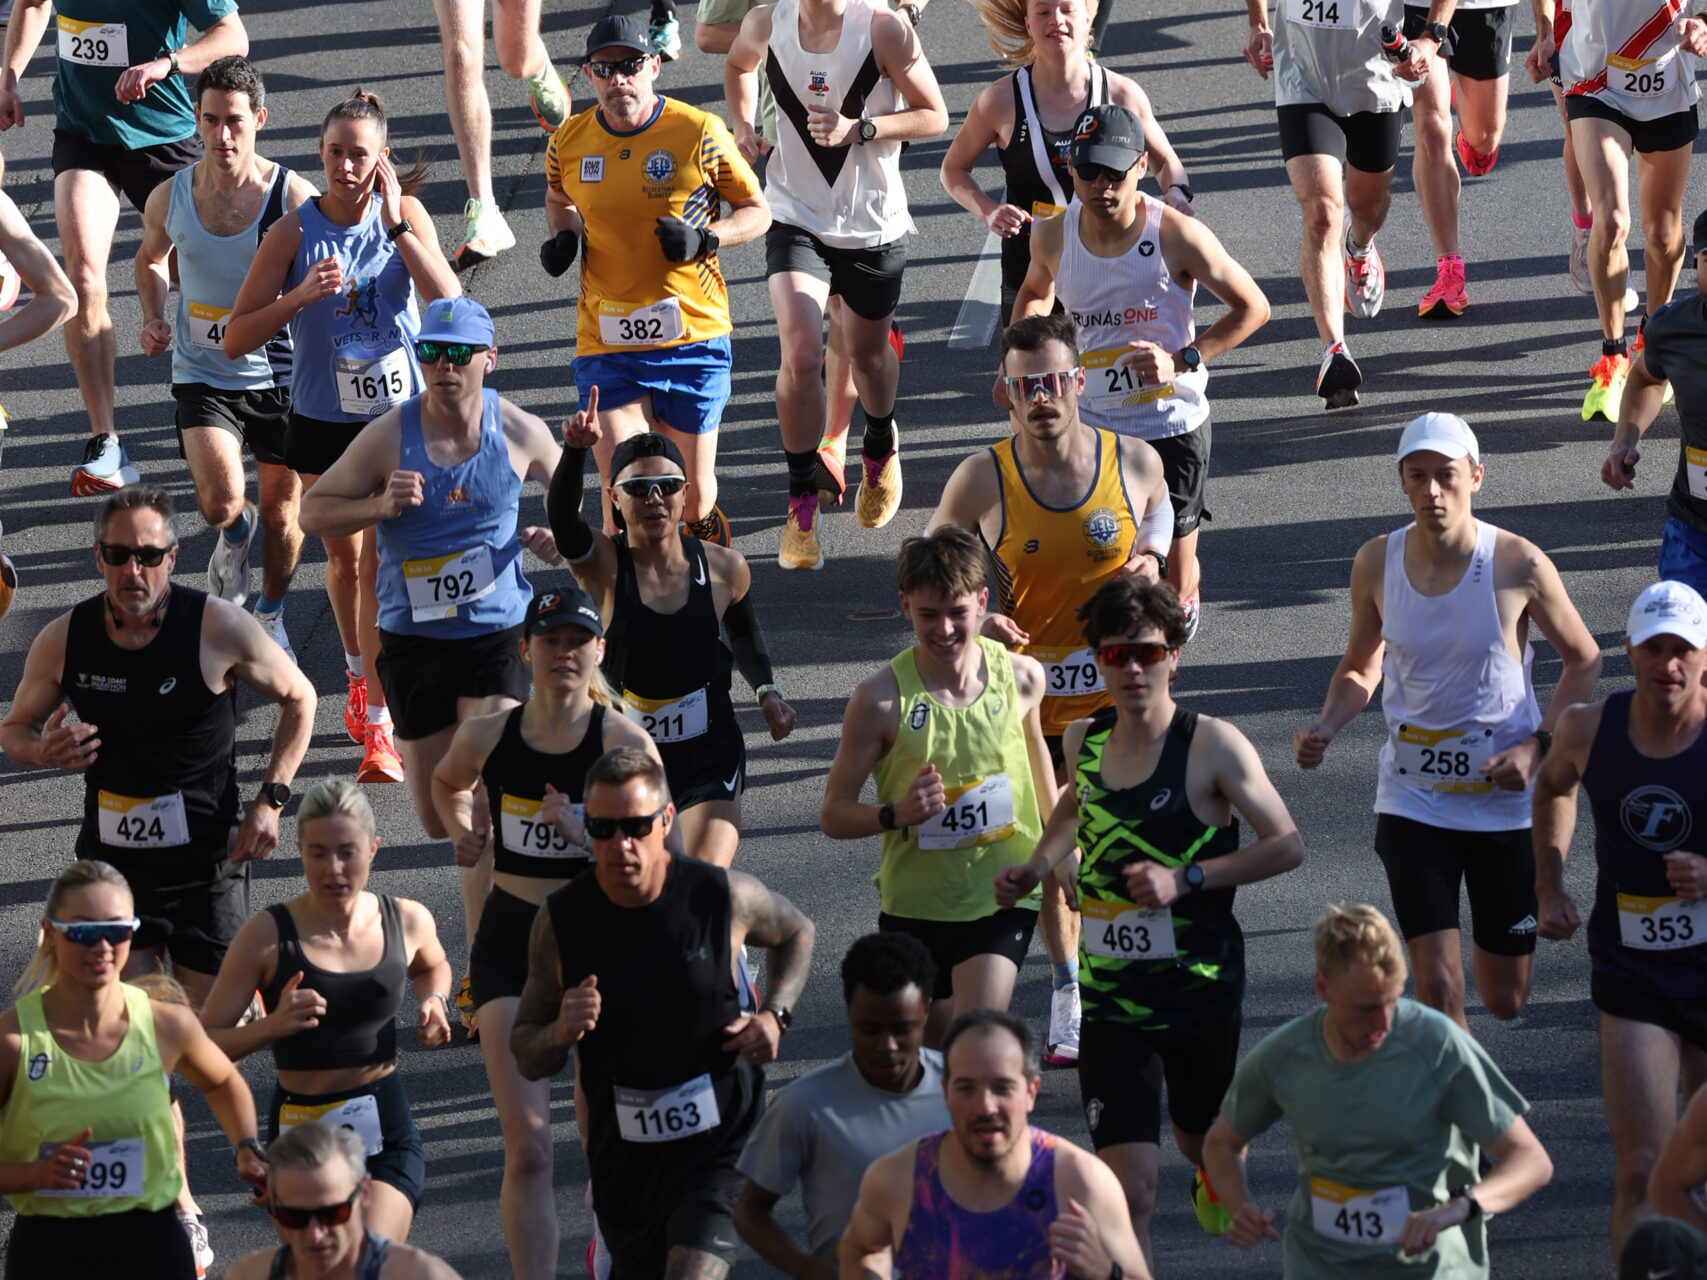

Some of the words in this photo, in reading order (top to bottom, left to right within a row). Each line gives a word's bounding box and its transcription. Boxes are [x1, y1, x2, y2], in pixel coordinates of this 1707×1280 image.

[71, 36, 110, 61] 239
[1623, 70, 1665, 93] 205
[647, 158, 671, 171] JETS
[333, 331, 362, 348] VETS
[619, 318, 664, 341] 382
[350, 371, 403, 401] 1615
[1105, 365, 1143, 392] 21
[426, 569, 477, 602] 792
[1050, 662, 1098, 690] 379
[642, 713, 684, 738] 211
[1419, 748, 1471, 777] 258
[116, 815, 165, 842] 424
[941, 800, 989, 832] 451
[520, 820, 568, 851] 795
[1102, 923, 1152, 954] 463
[1641, 914, 1694, 944] 353
[634, 1101, 702, 1135] 1163
[1335, 1207, 1384, 1239] 413
